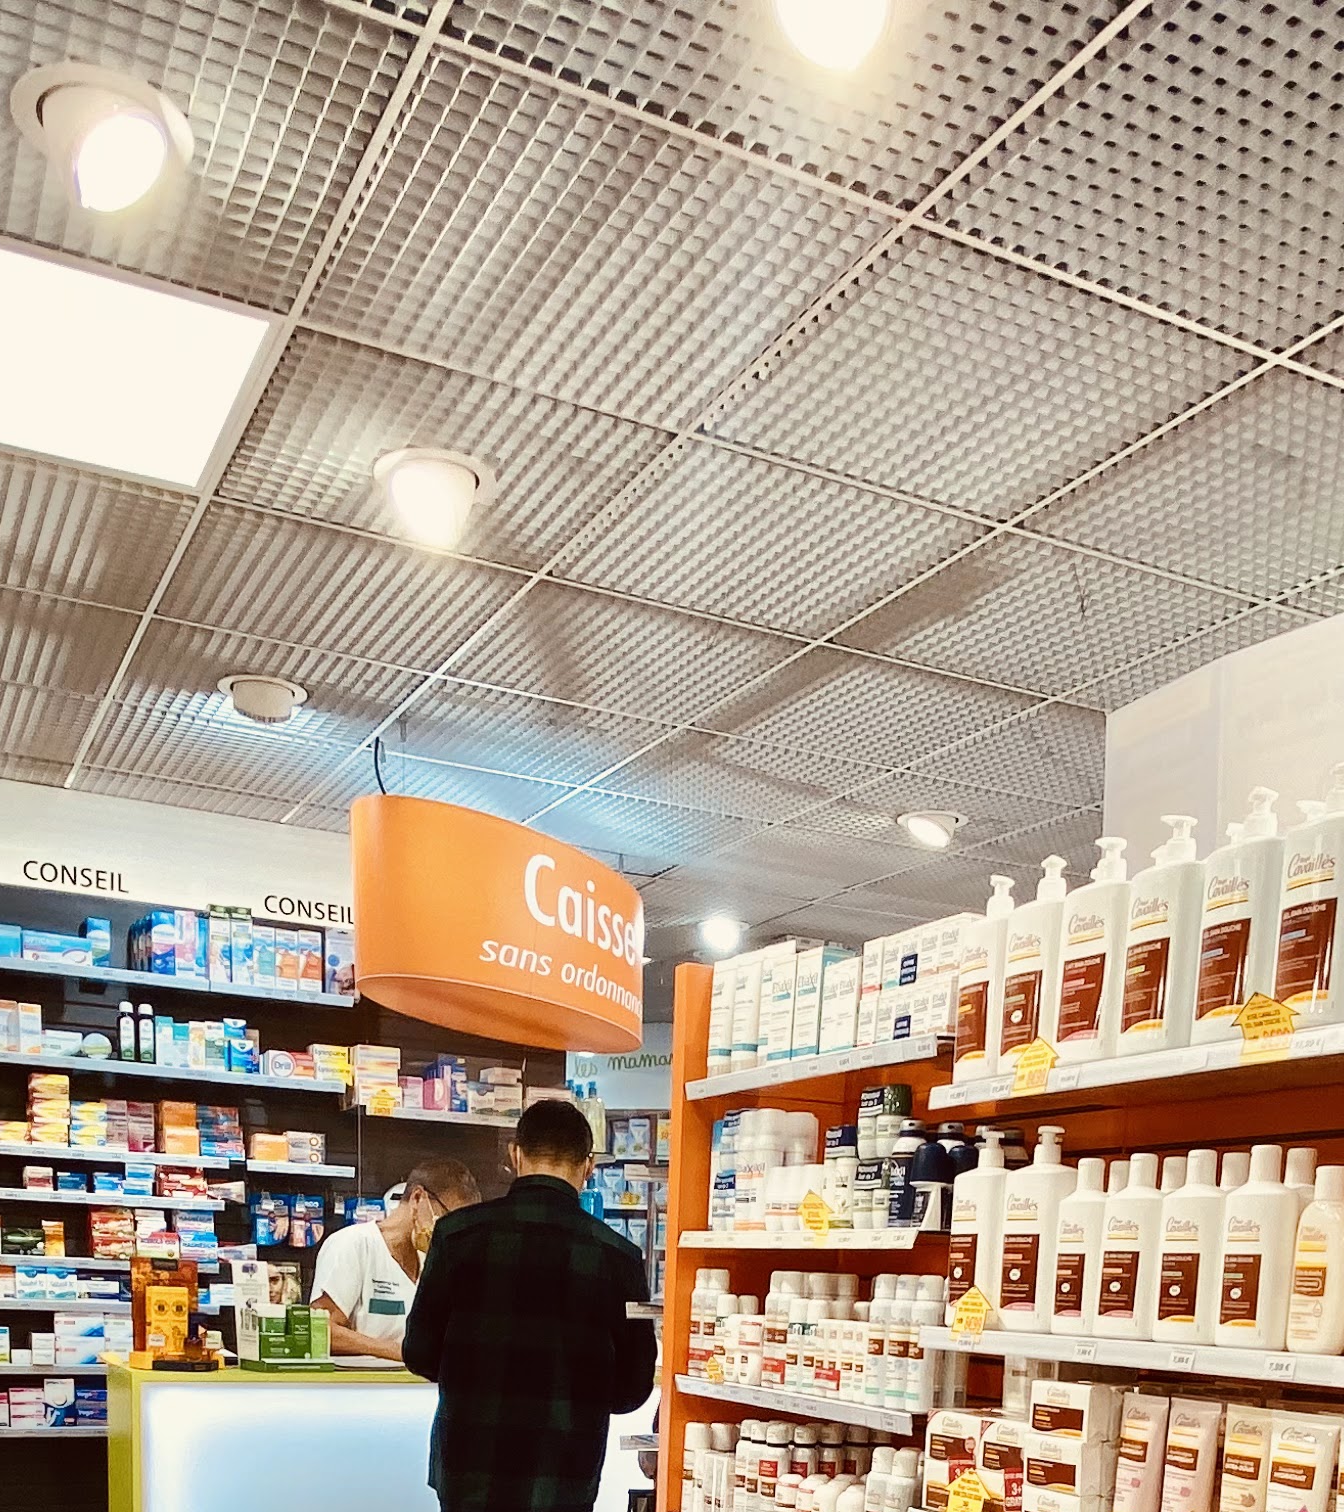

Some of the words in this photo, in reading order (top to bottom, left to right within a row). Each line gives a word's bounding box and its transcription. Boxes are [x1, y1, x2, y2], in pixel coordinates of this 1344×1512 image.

[23, 860, 129, 893] CONSEIL
[264, 895, 354, 925] CONSEIL
[524, 854, 644, 966] Caisse
[479, 940, 551, 977] sans
